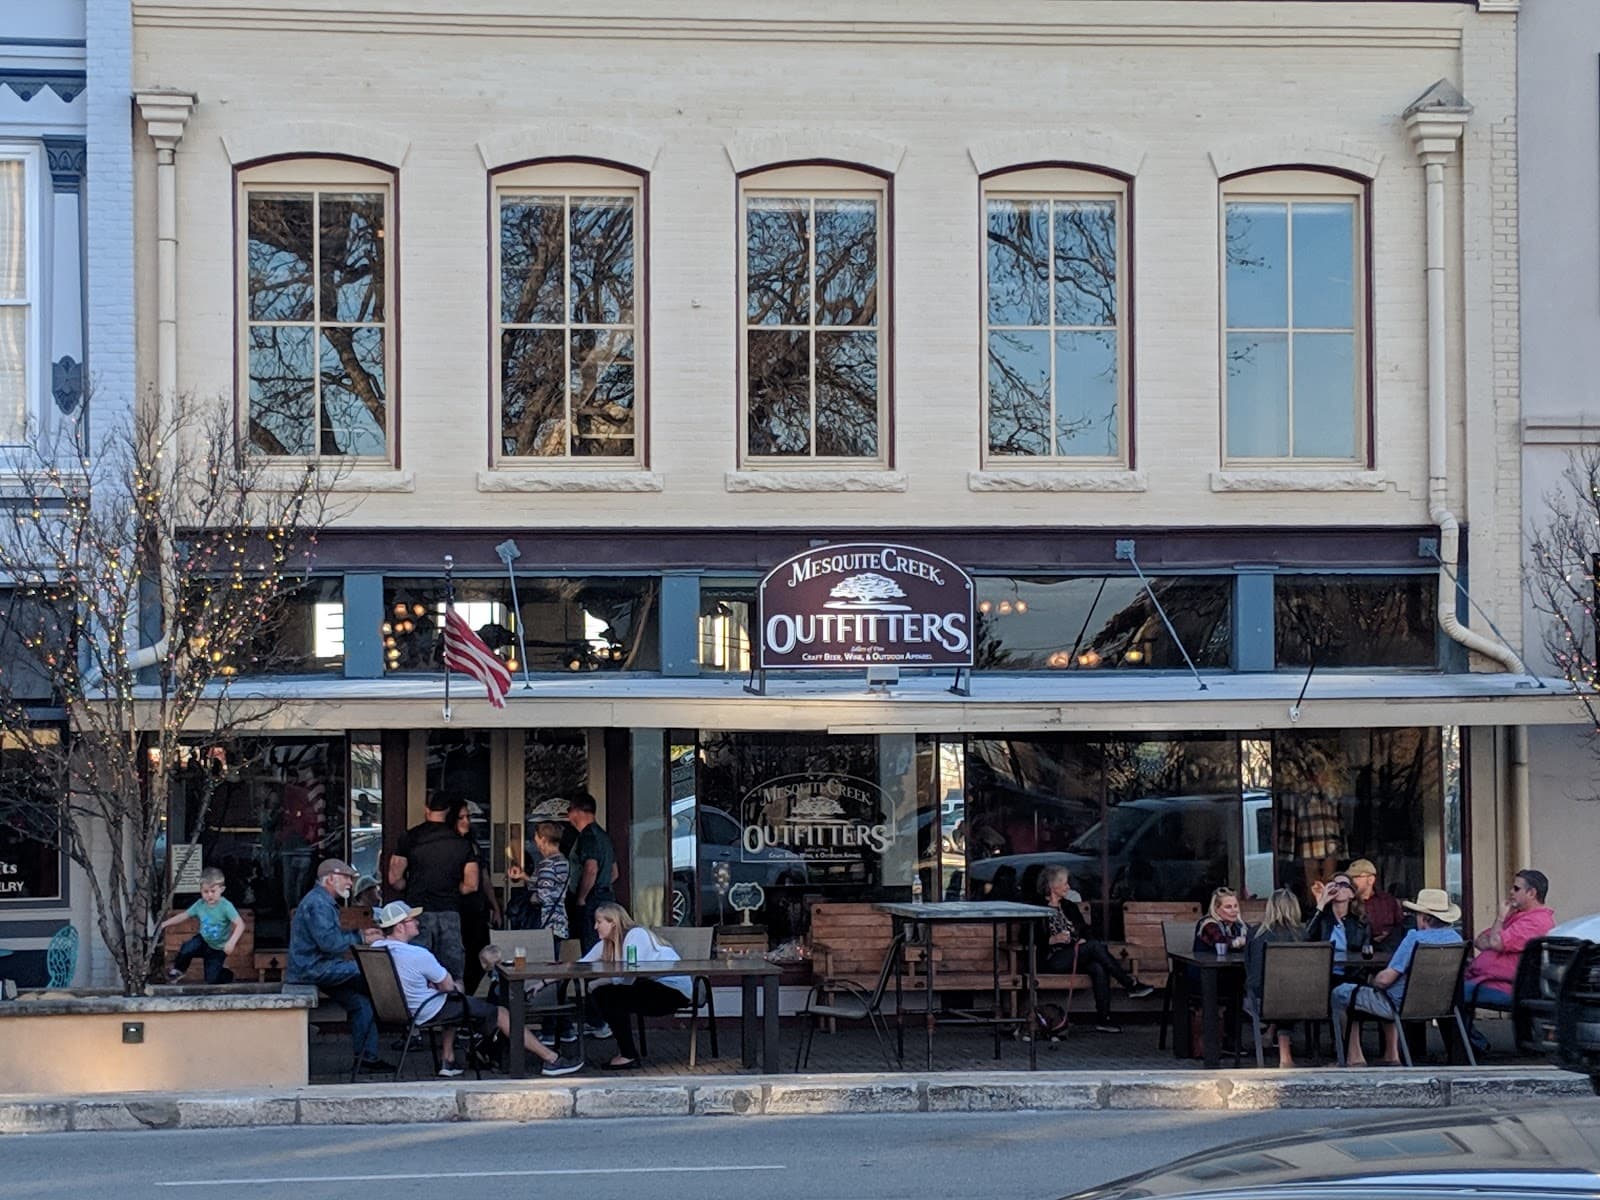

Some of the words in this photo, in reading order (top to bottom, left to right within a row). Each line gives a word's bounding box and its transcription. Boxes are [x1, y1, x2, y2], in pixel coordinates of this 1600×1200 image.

[788, 553, 880, 588] MESQUITE
[880, 548, 945, 586] CREEK
[766, 612, 969, 654] OUTFITTERS
[744, 825, 891, 854] OUTFITTERS
[0, 860, 18, 874] ts
